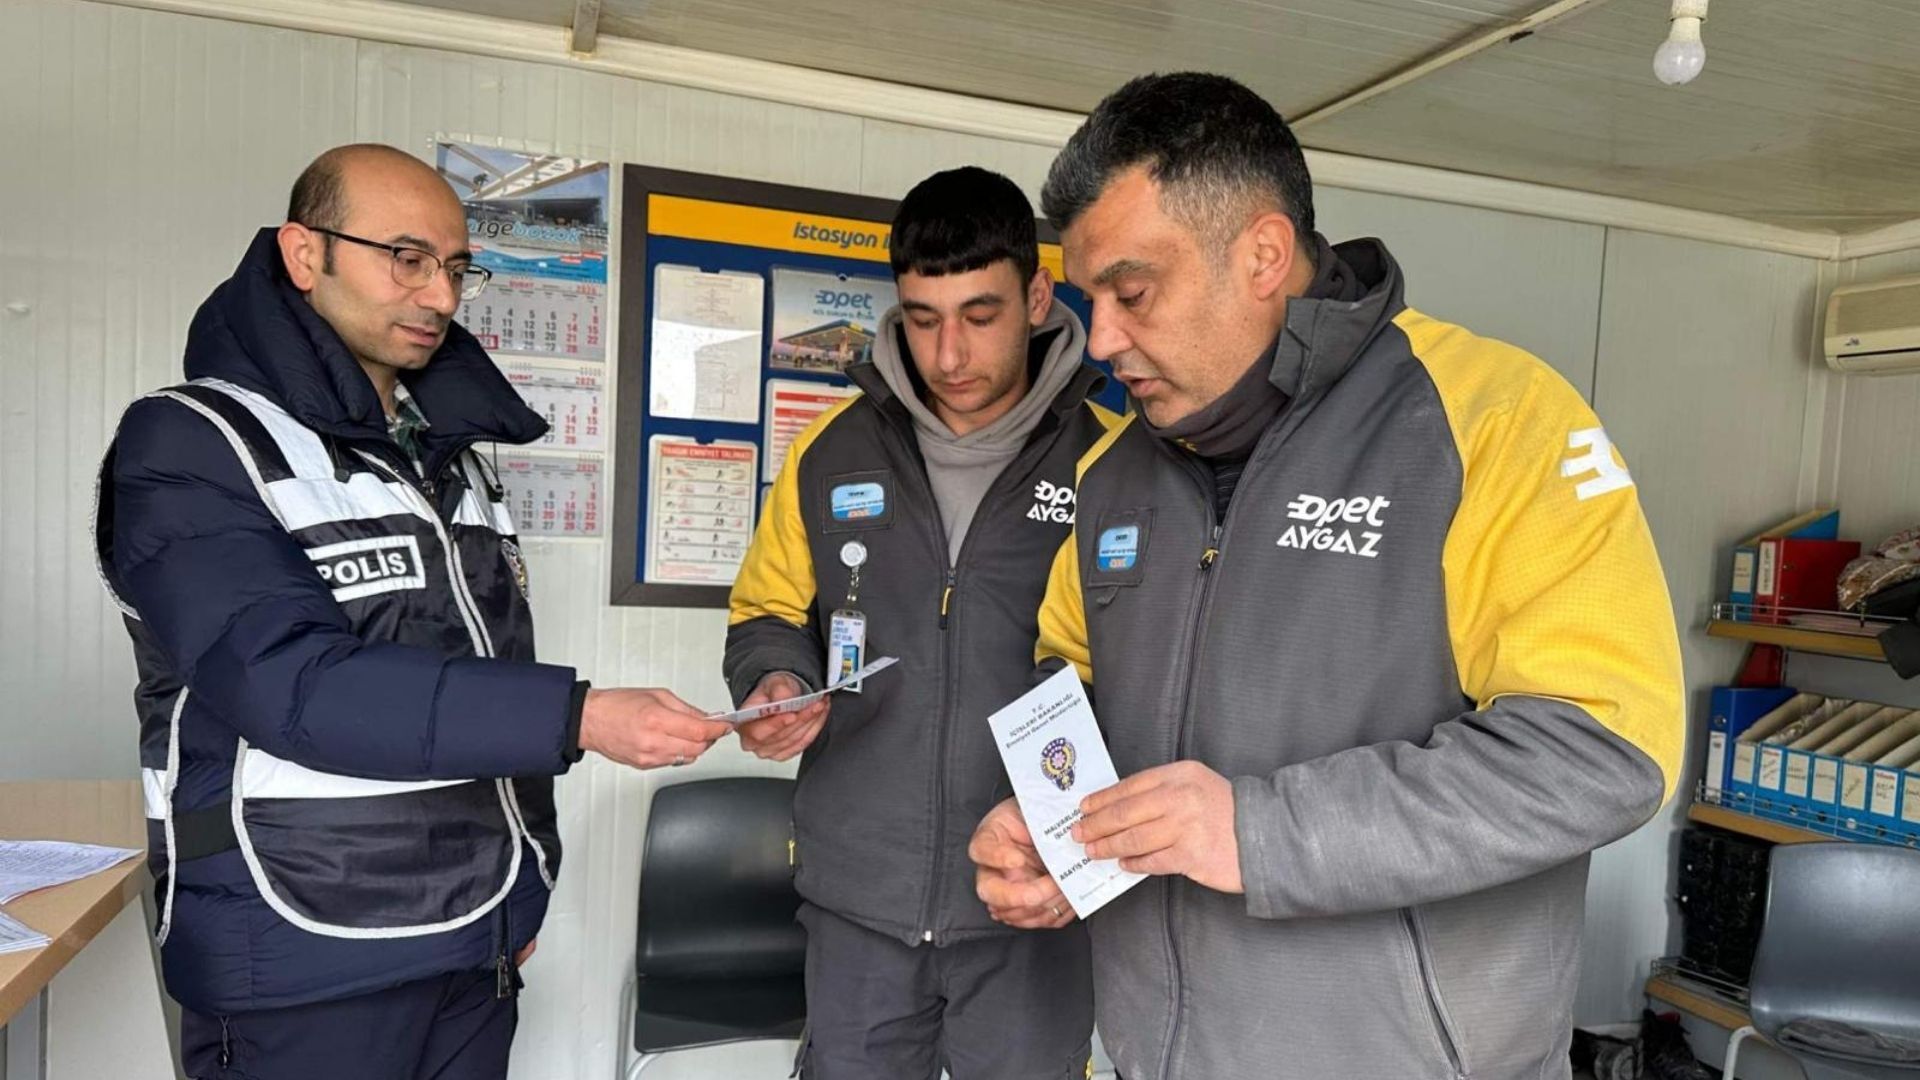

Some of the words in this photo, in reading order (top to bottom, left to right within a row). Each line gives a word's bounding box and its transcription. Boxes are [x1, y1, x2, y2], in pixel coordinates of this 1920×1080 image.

[1034, 480, 1075, 506] op
[1026, 503, 1075, 524] AYG
[1276, 524, 1383, 558] AYGAZ
